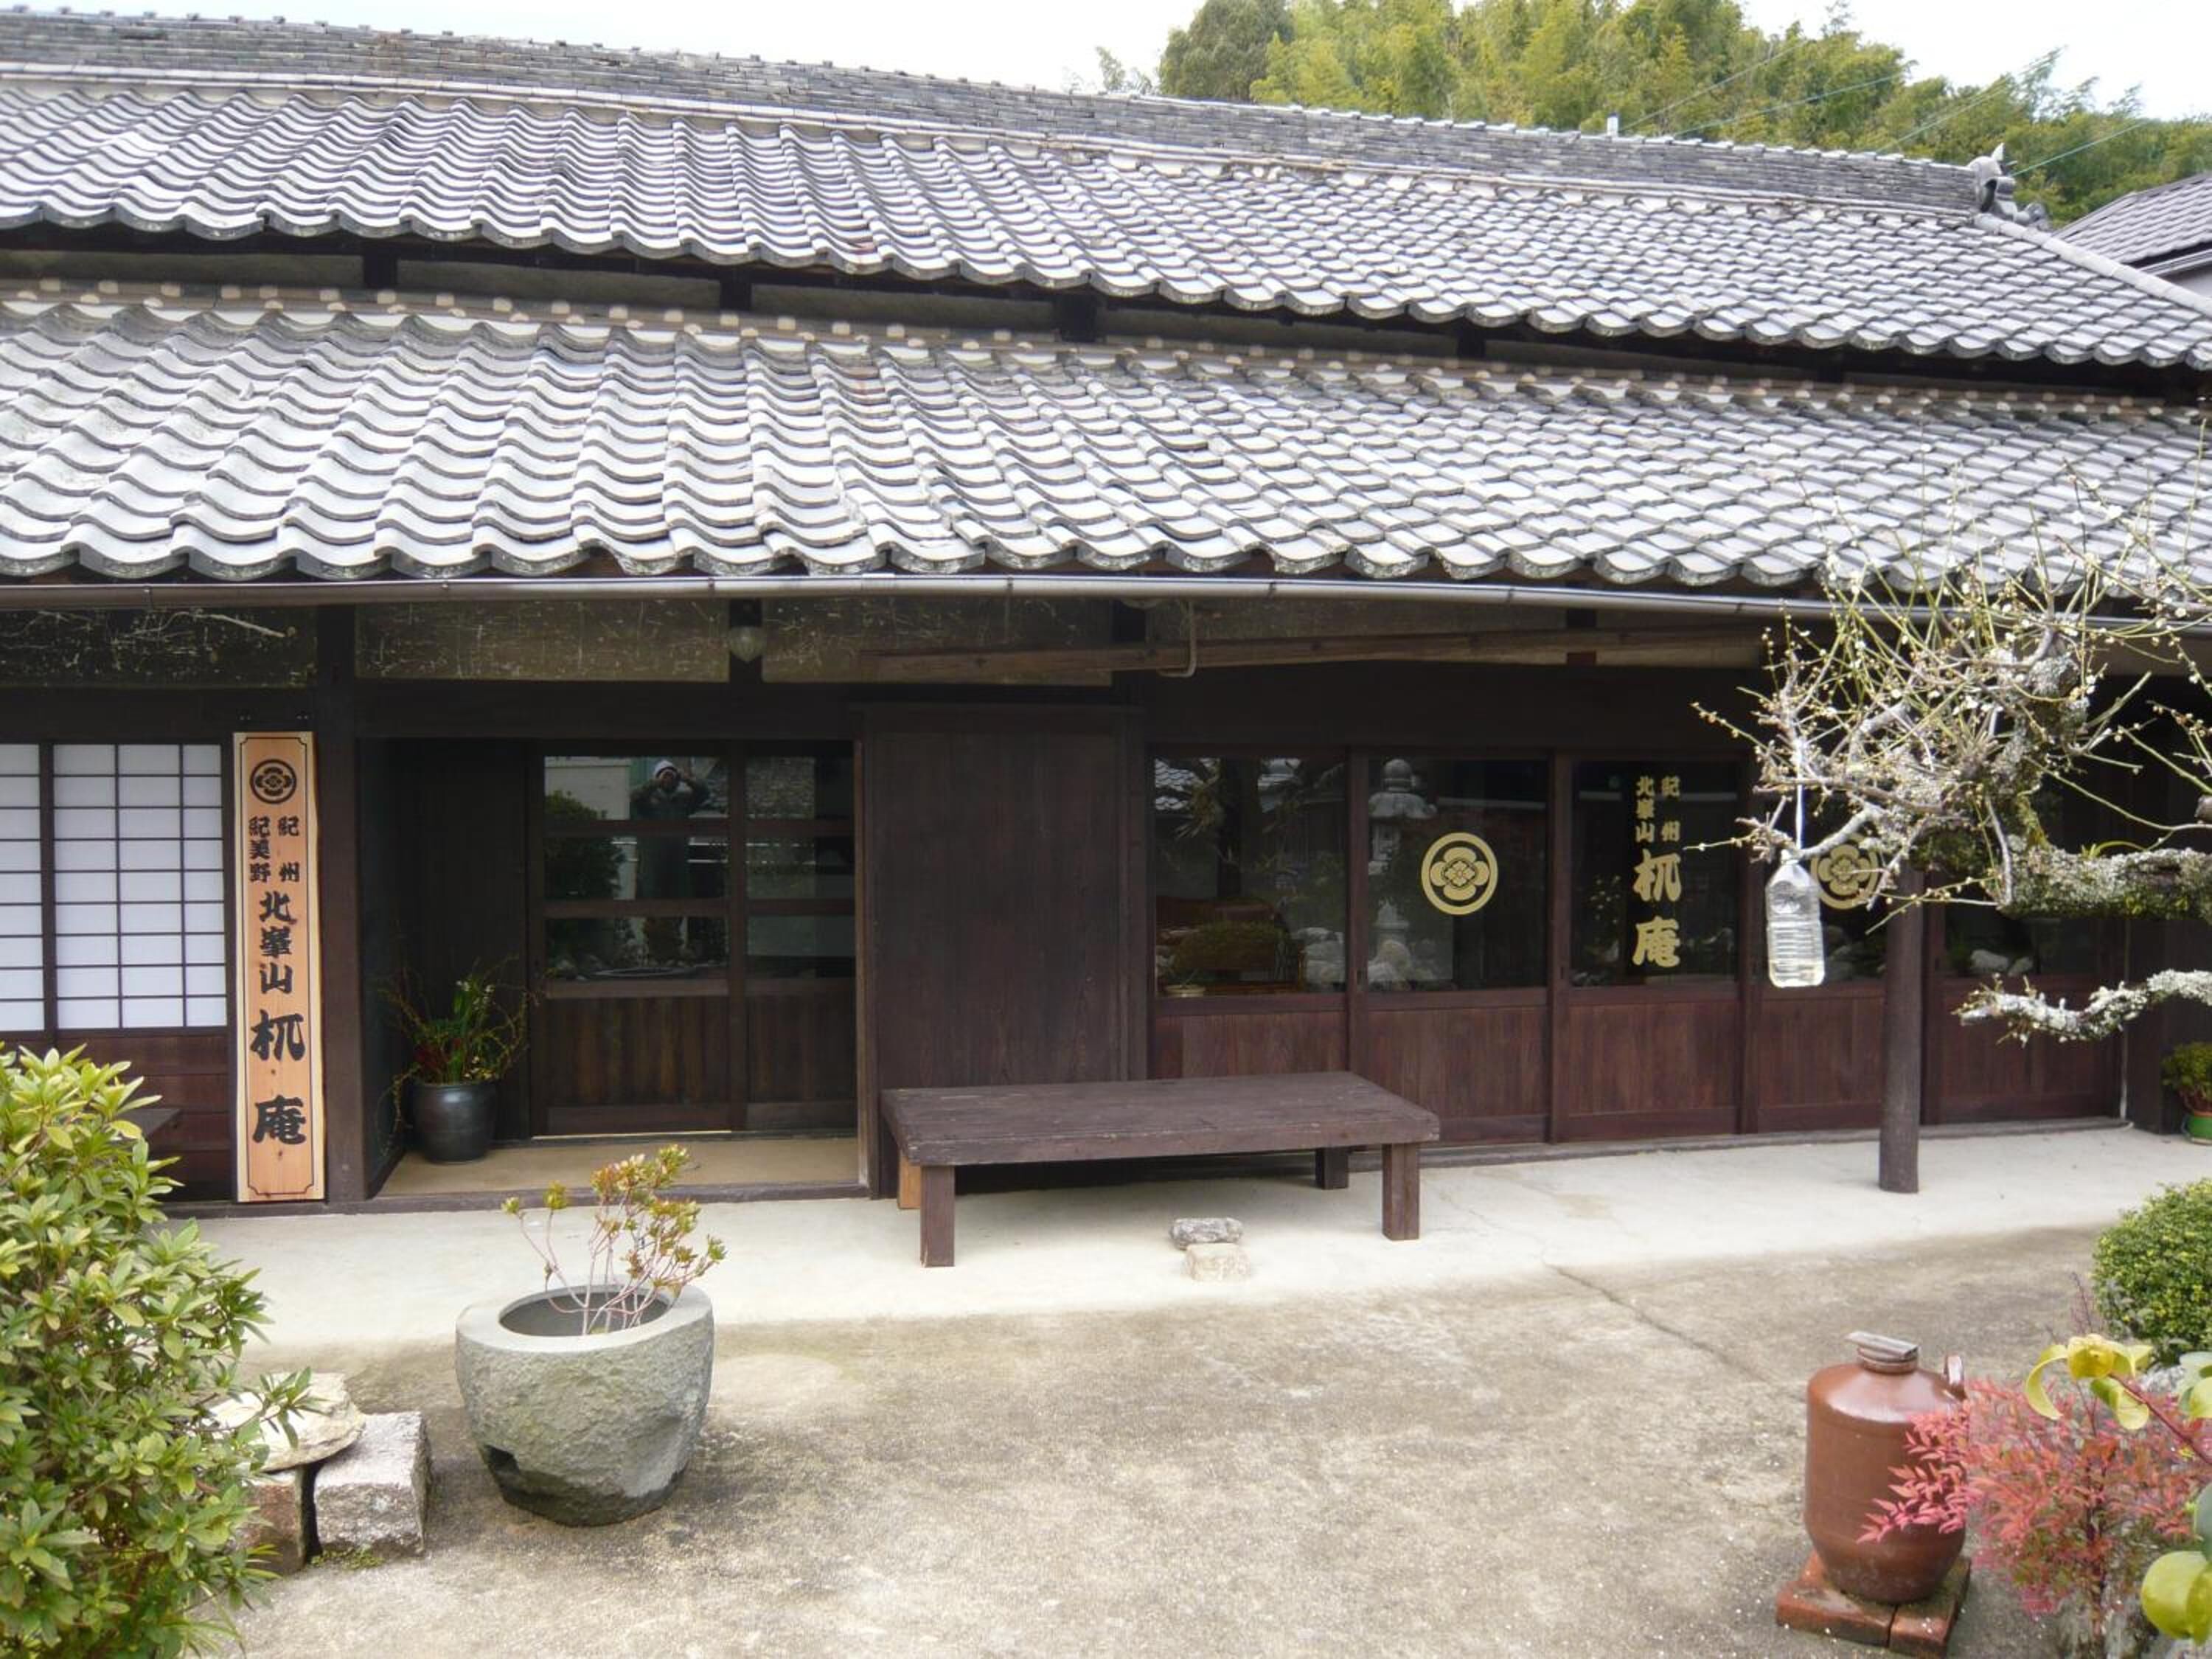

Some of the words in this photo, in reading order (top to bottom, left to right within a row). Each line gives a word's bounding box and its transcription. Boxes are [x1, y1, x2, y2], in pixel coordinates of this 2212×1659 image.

[248, 816, 271, 883] 紀美野
[277, 816, 300, 883] 紀州
